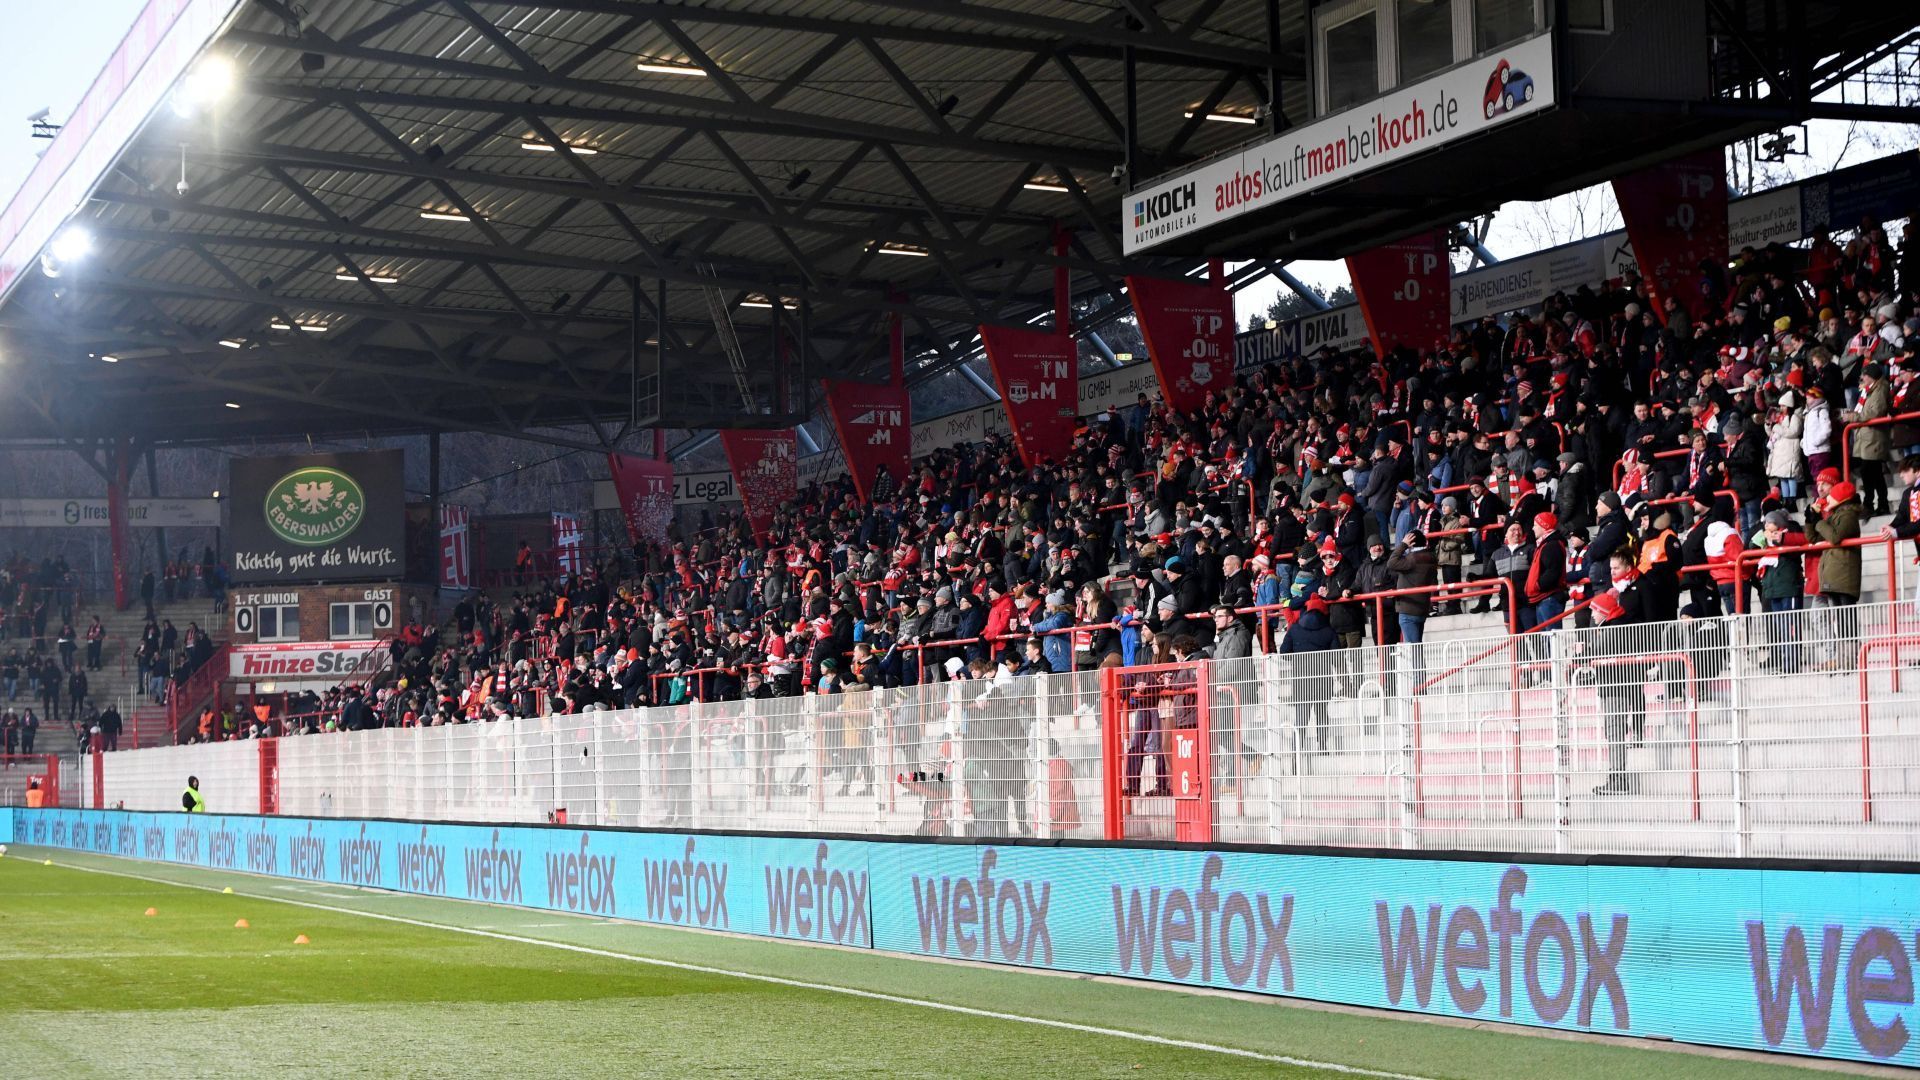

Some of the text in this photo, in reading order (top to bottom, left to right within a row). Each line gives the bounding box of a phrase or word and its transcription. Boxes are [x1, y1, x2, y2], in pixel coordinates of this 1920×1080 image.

[1214, 90, 1459, 212] autoskauftmanbeikoch.de
[1145, 181, 1196, 224] KOCH
[1135, 212, 1197, 245] AUTOMOBILE AG
[1728, 218, 1797, 247] hkultur-gmbh.de
[1468, 269, 1533, 302] BÄRENDIENST
[1305, 313, 1348, 346] DIVAL
[685, 474, 733, 501] Legal
[269, 502, 360, 537] EBERSWALDER
[236, 545, 396, 574] Richtig gut die Wurst.
[235, 592, 299, 606] 1. FC UNION
[364, 589, 393, 601] GAST
[237, 608, 252, 632] 0
[375, 603, 391, 627] 0
[1176, 734, 1194, 758] Tor
[1181, 770, 1189, 794] 6
[143, 816, 165, 859] wefox
[174, 816, 199, 862] wefox
[209, 818, 236, 868] wefox
[246, 818, 277, 872] wefox
[290, 821, 326, 879] wefox
[339, 823, 381, 885] wefox
[398, 826, 446, 894] wefox
[464, 828, 522, 903] wefox
[546, 829, 616, 914] wefox
[643, 836, 729, 928] wefox
[765, 842, 869, 945] wefox
[912, 847, 1053, 965] wefox
[1112, 852, 1294, 992] wefox
[1375, 865, 1630, 1030] wefox
[1745, 919, 1920, 1059] we
